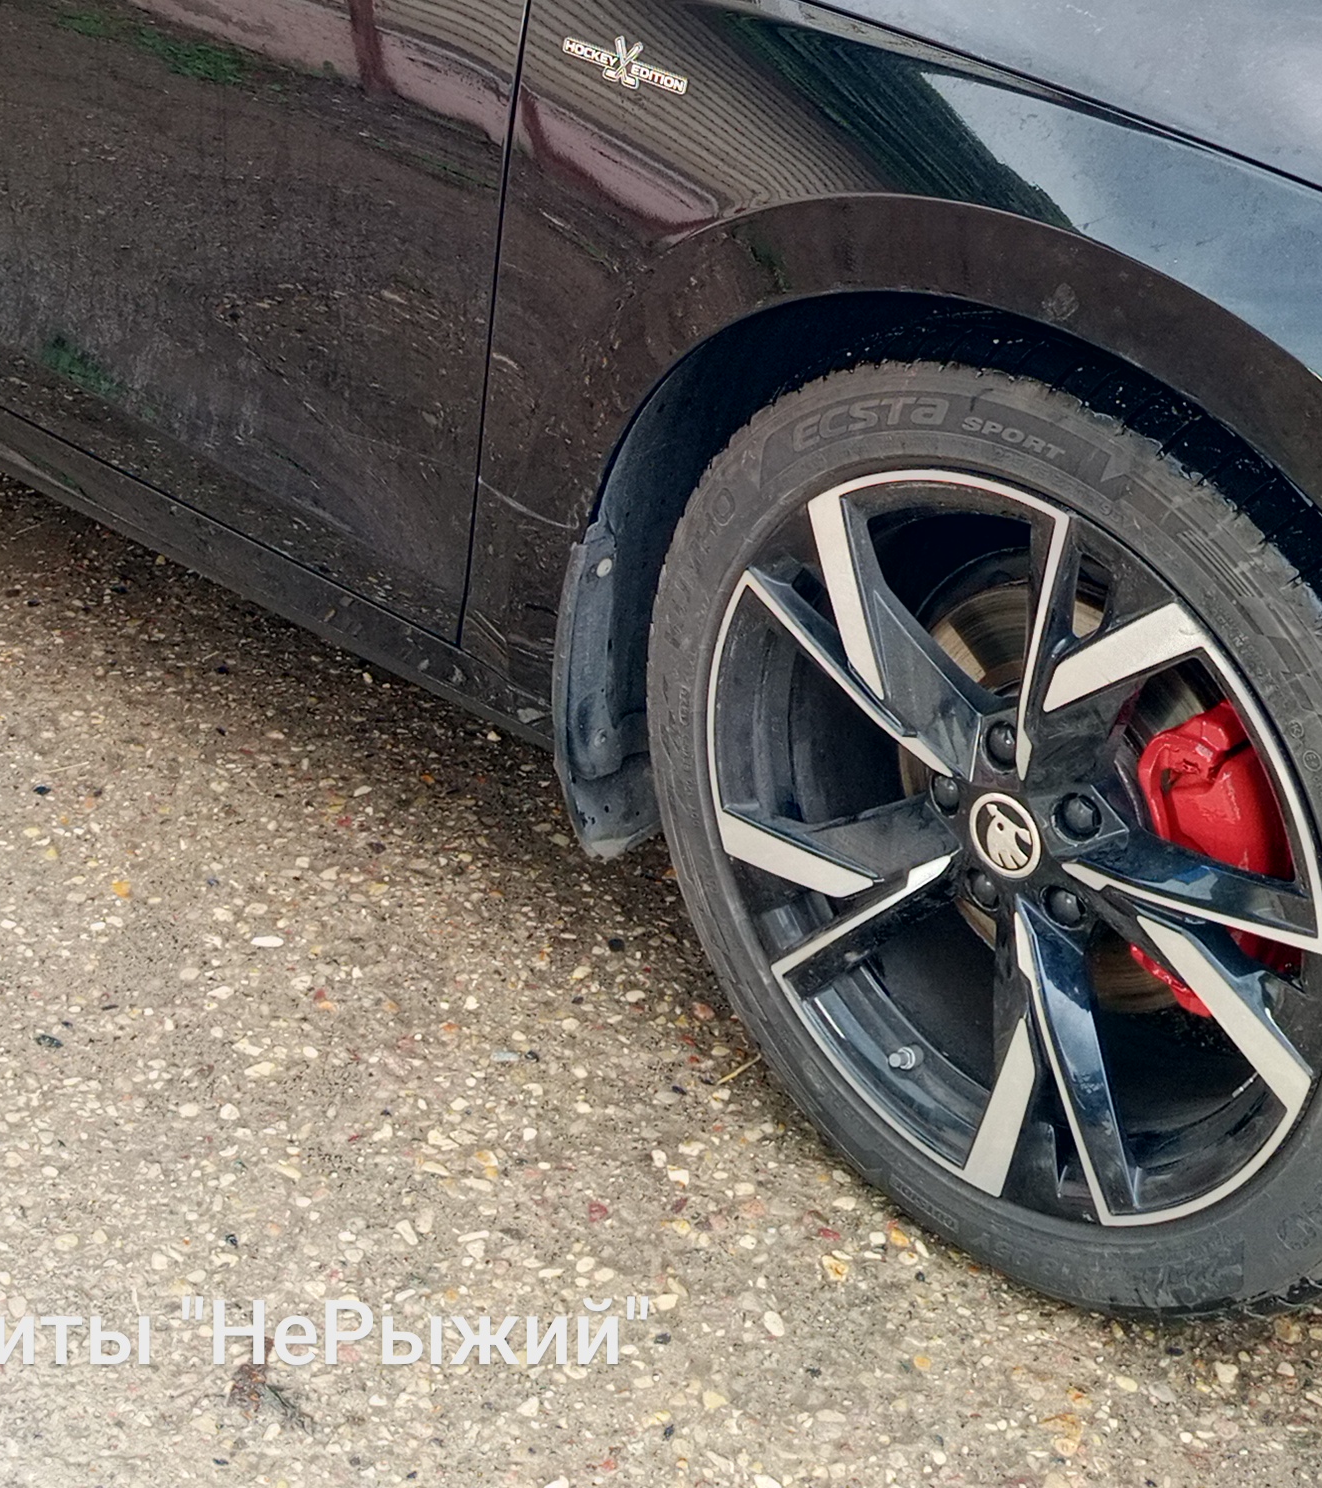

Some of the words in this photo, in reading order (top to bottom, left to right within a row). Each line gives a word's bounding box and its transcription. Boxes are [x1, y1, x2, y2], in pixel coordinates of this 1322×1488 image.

[565, 41, 619, 67] HOCKEY
[630, 64, 684, 92] EDITION
[961, 416, 1066, 461] SPORT
